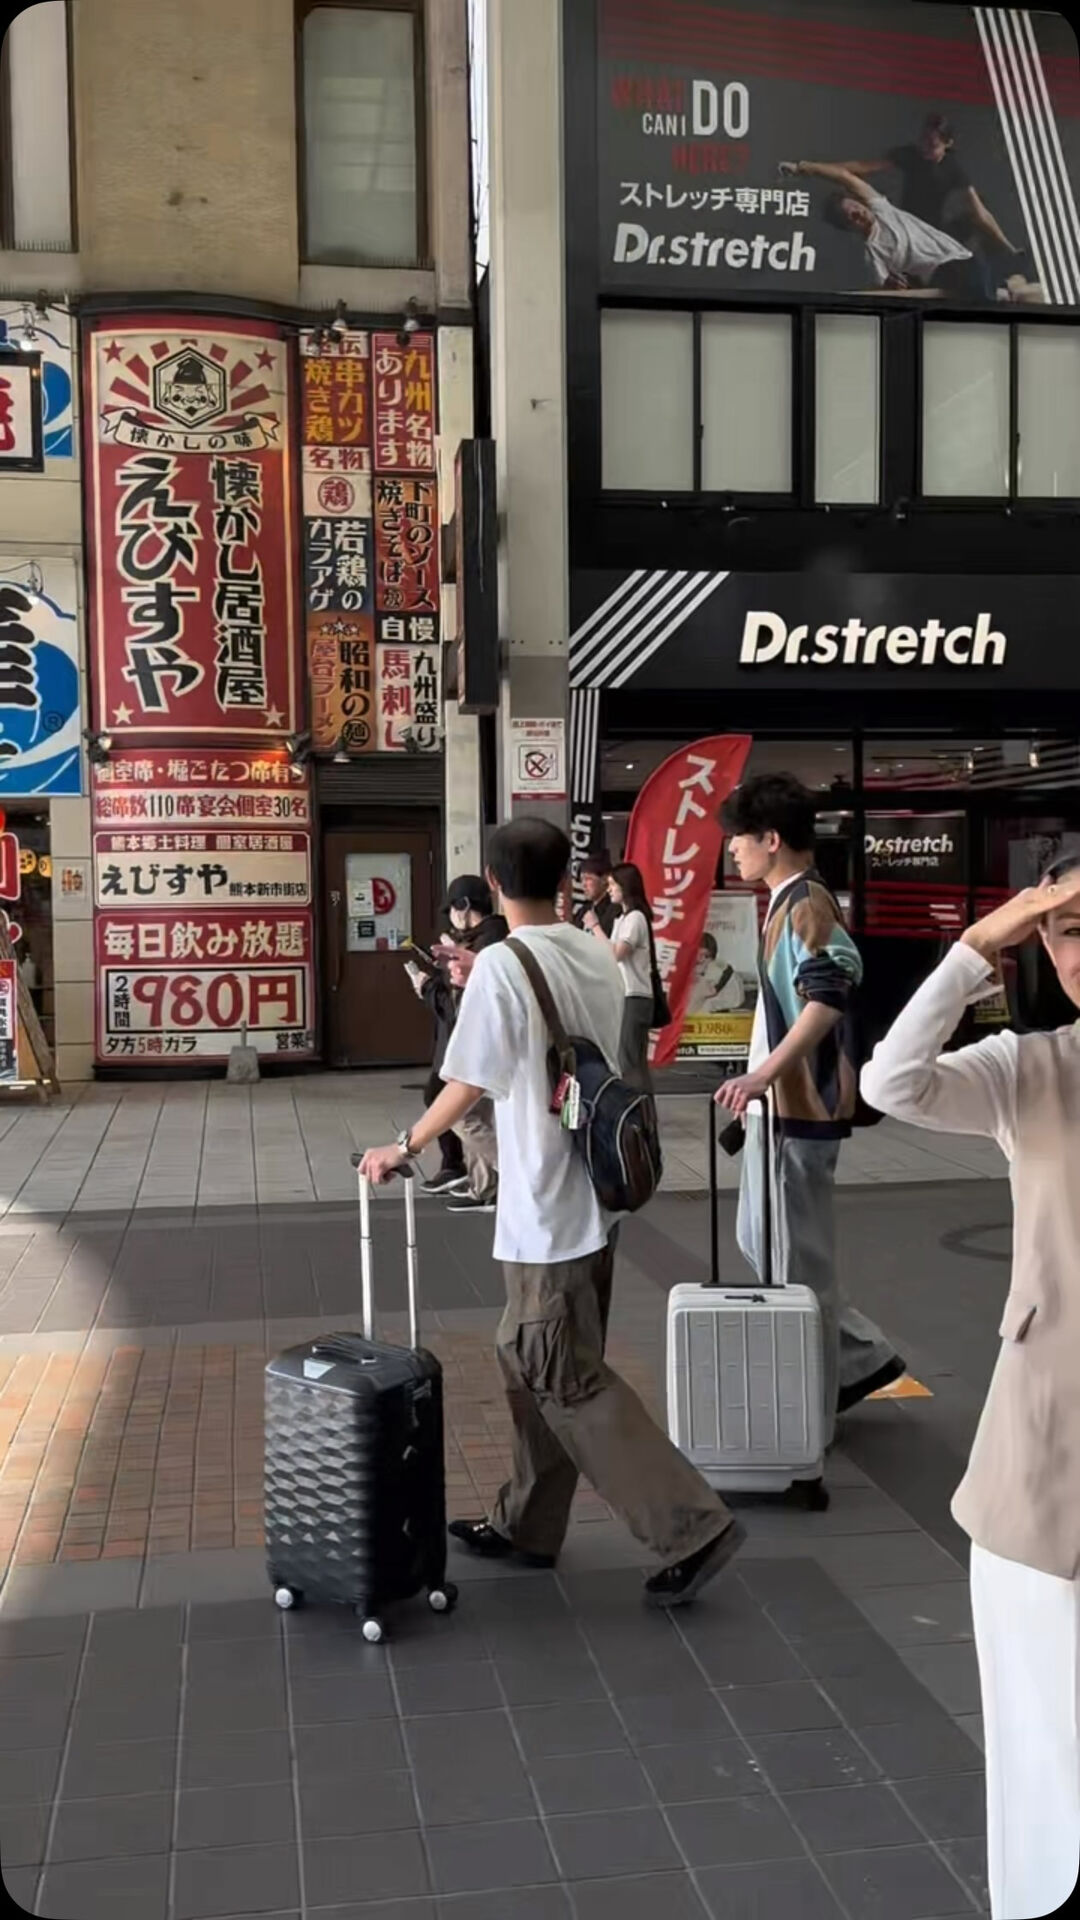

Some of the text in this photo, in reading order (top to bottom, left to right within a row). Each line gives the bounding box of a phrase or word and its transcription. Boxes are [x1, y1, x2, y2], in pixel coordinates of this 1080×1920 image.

[642, 113, 677, 136] CAN
[692, 80, 749, 138] DO
[619, 182, 810, 217] ストレッチ専門店
[613, 222, 816, 271] Dr.stretch
[304, 358, 334, 444] 焼き鶏
[335, 359, 366, 442] 串カツ
[376, 348, 404, 466] あります
[404, 350, 431, 467] 九州名物
[130, 427, 253, 450] 懐かしの味
[308, 448, 364, 470] 名物
[309, 518, 334, 611] カラアゲ
[334, 520, 368, 611] 若鶏の
[404, 480, 436, 612] 下町のソース
[115, 452, 204, 712] えびすや
[209, 455, 268, 713] 懐かし居酒屋
[381, 617, 434, 641] 自慢
[739, 610, 1007, 665] Dr.stretch
[382, 649, 411, 748] 馬刺し
[413, 651, 438, 748] 九州盛り
[101, 863, 228, 896] えびすや
[104, 920, 305, 960] 毎日飲み放題
[114, 975, 130, 1028] 2時間
[133, 973, 298, 1028] 980円
